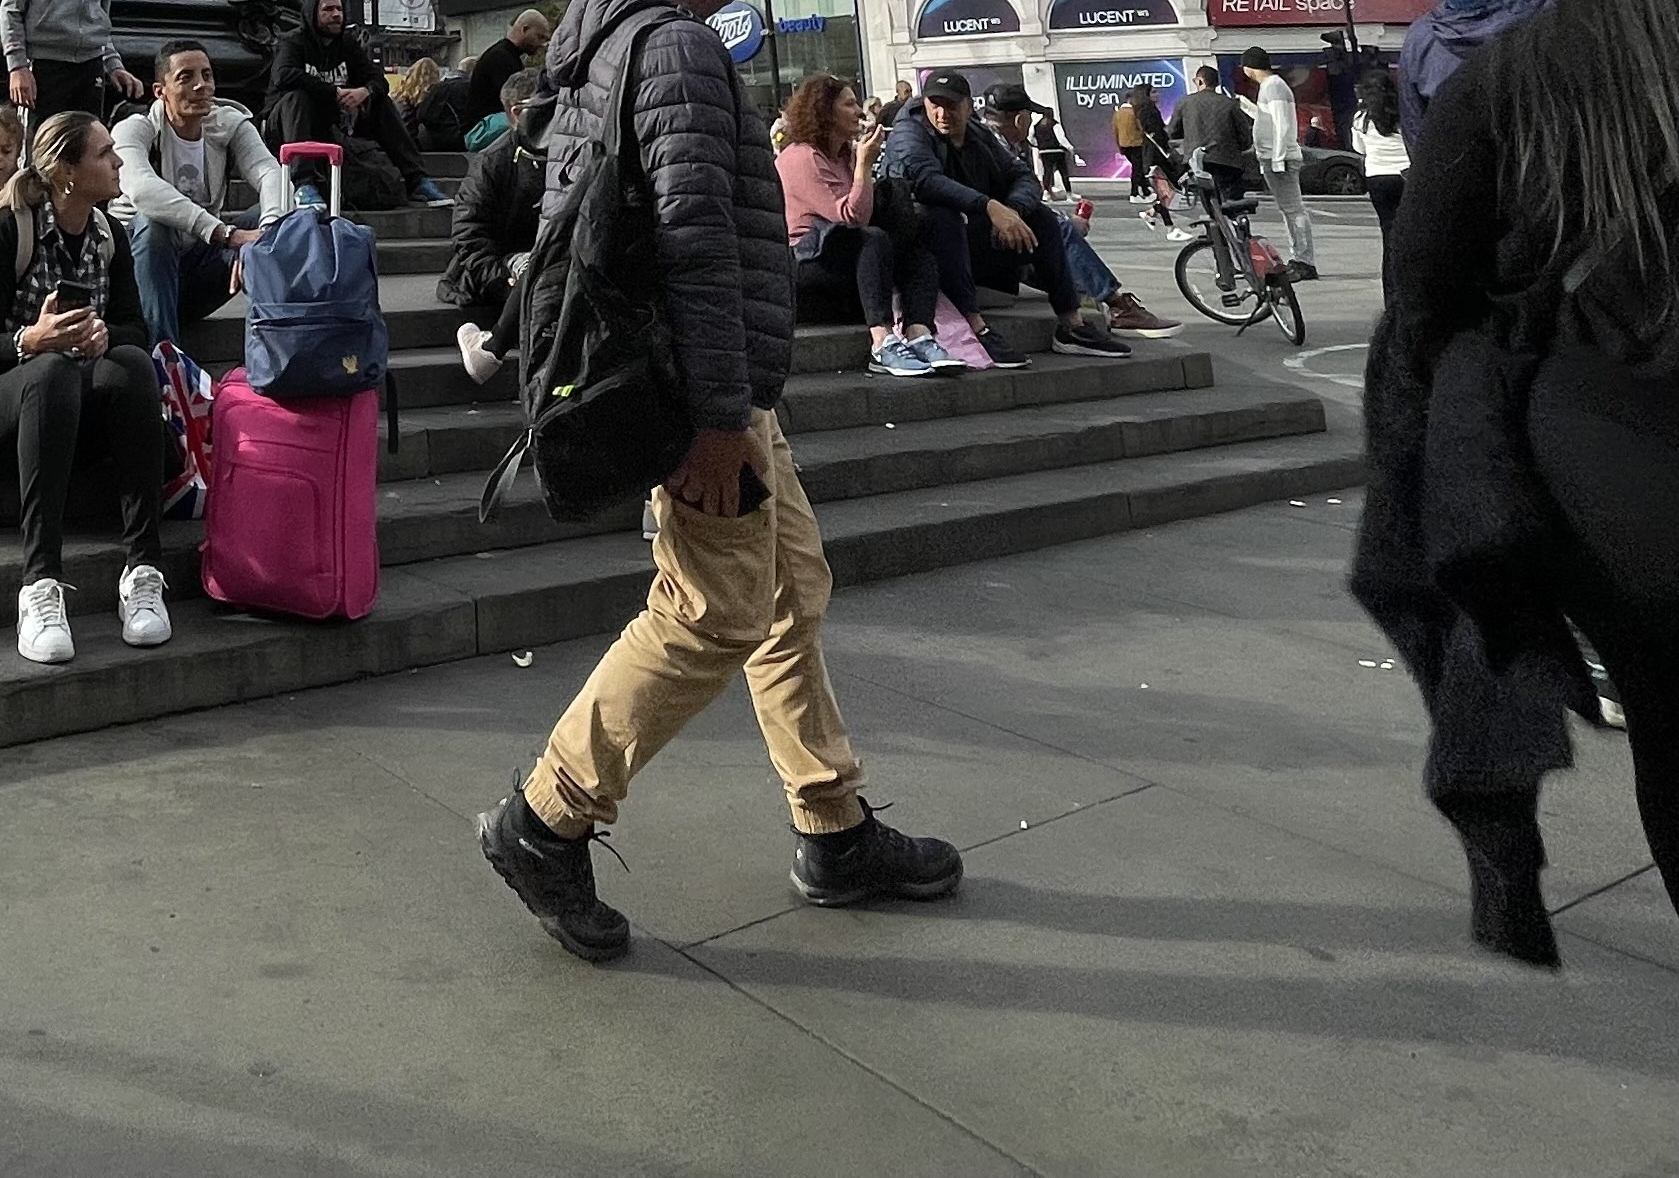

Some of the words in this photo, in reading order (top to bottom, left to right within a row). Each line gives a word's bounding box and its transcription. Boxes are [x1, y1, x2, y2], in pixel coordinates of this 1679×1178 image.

[777, 14, 826, 33] beauty
[943, 17, 989, 33] LUCENT
[1079, 9, 1135, 25] LUCENT
[1065, 72, 1175, 91] ILLUMINATED
[1076, 91, 1096, 109] by
[1098, 92, 1119, 106] an
